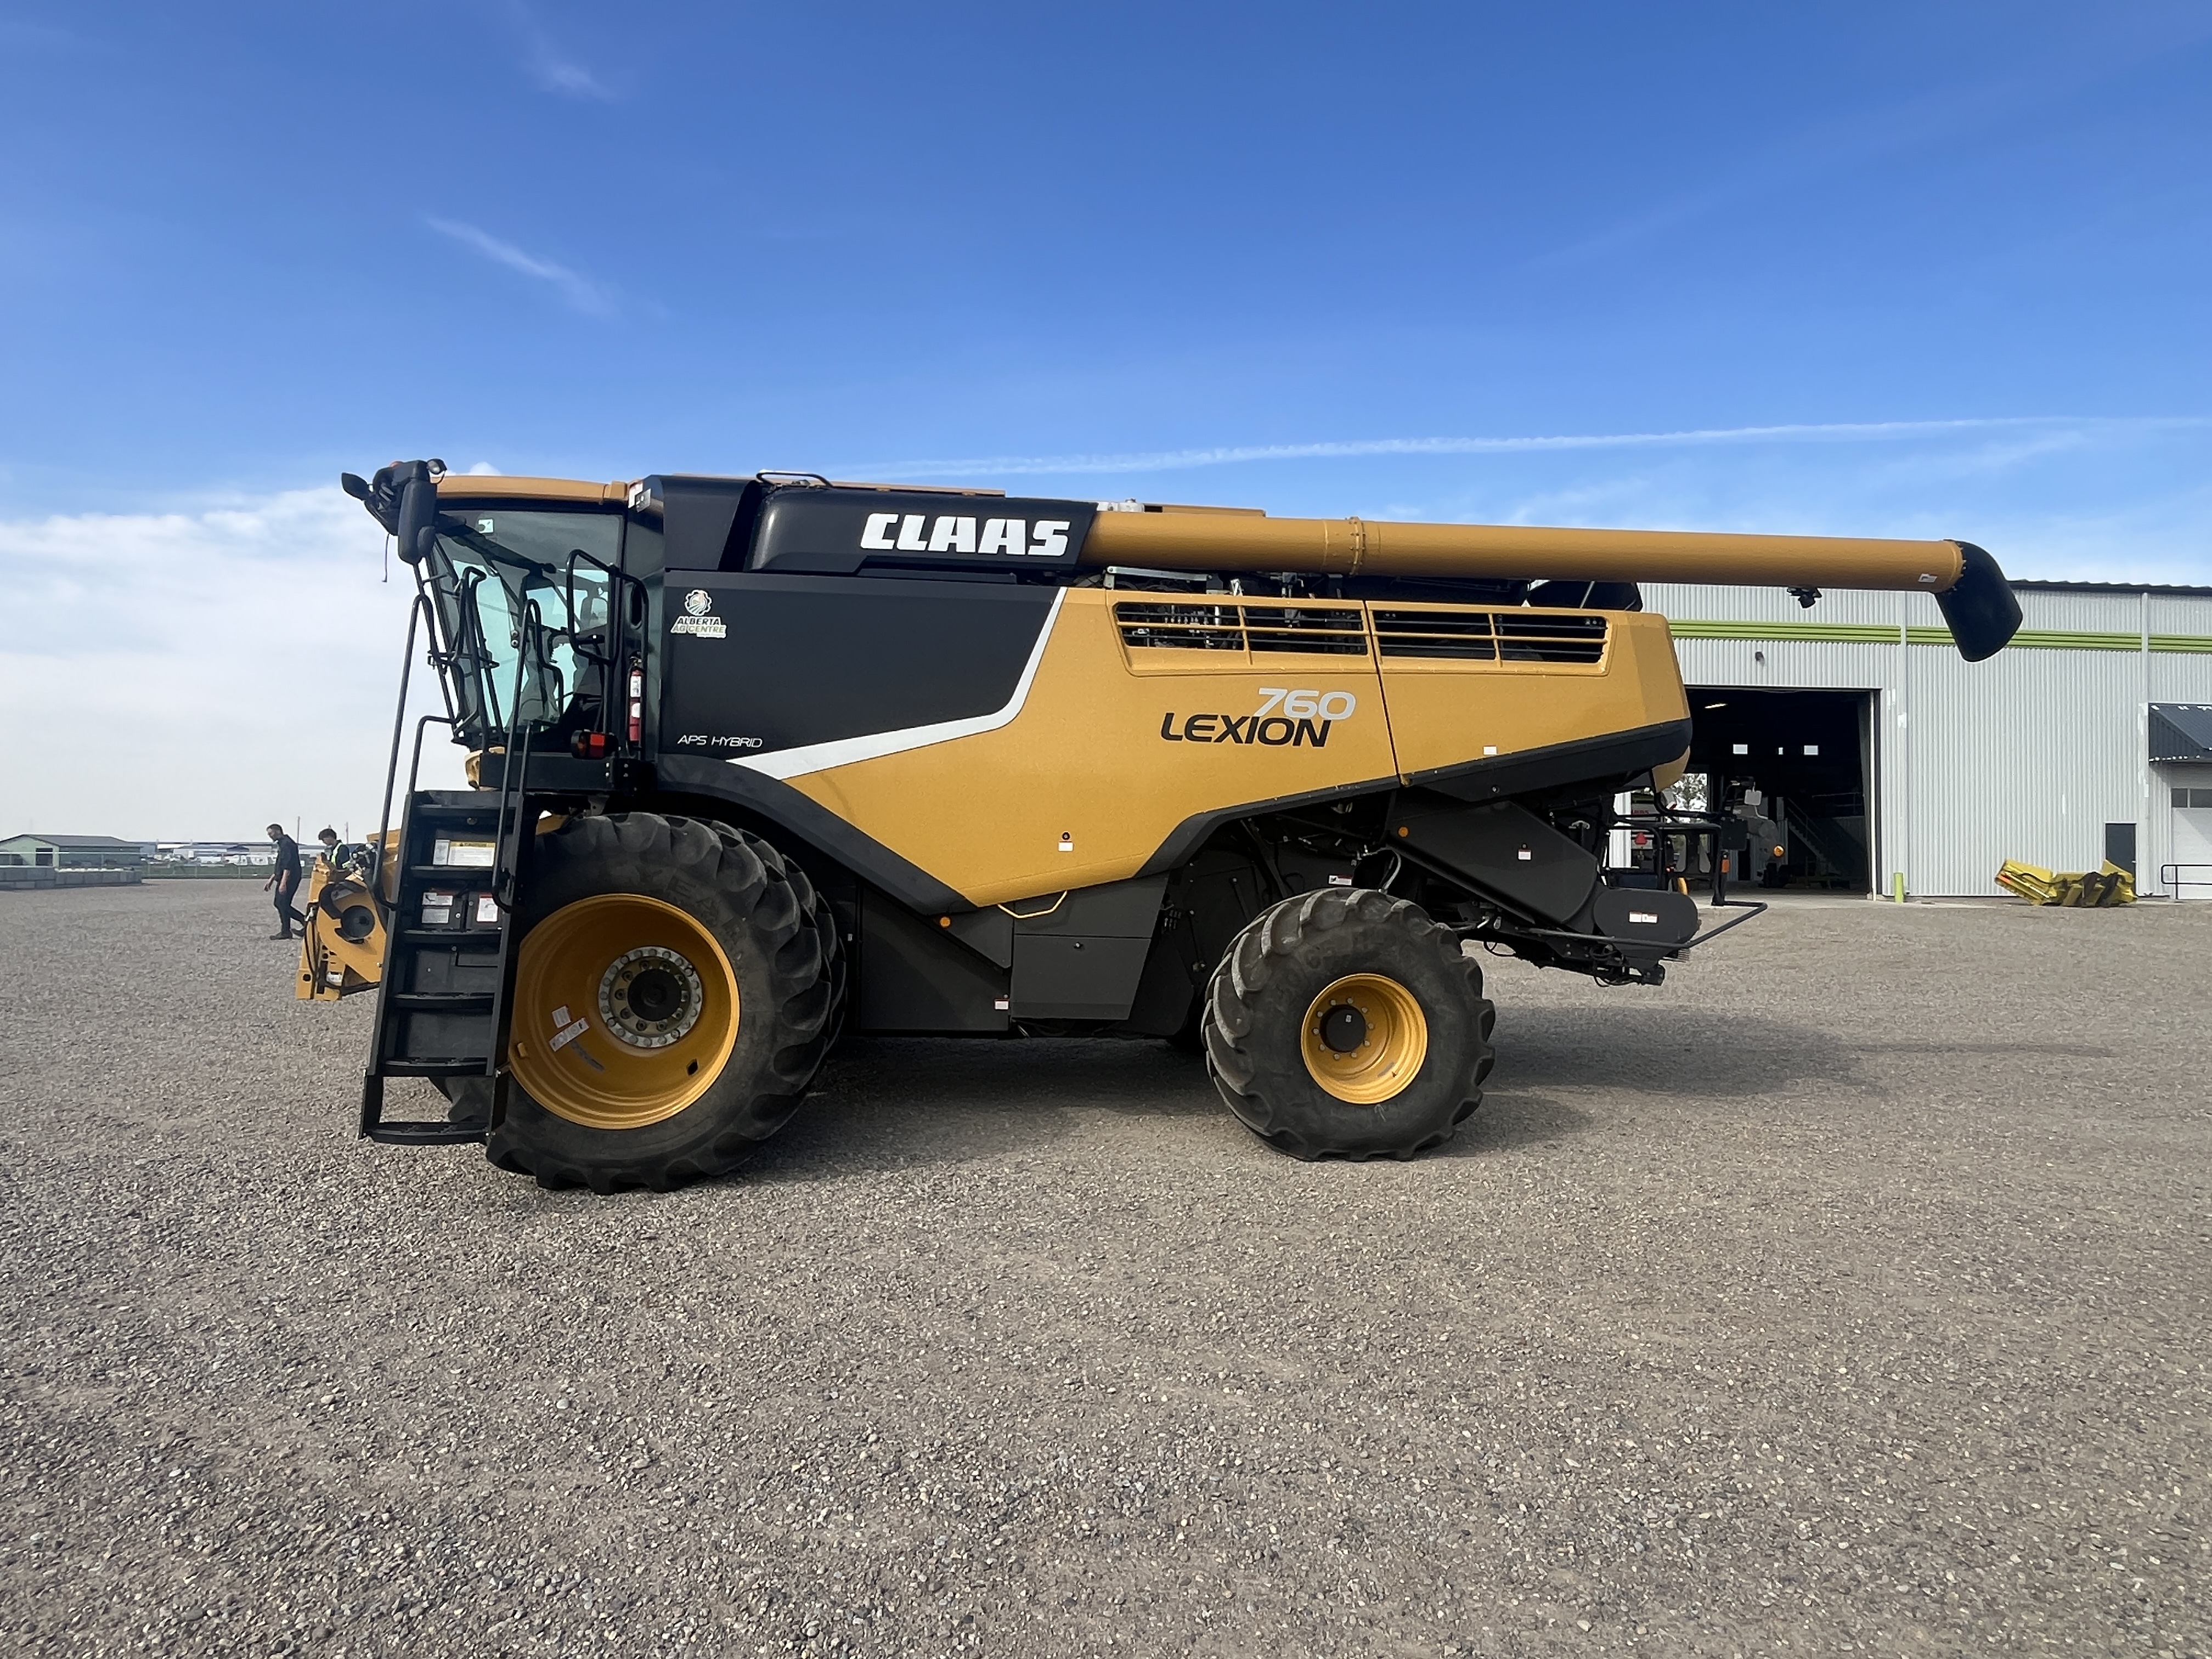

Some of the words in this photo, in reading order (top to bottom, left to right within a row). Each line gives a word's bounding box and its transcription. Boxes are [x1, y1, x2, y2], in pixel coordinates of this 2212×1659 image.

[860, 512, 1071, 556] CLAAS
[1254, 687, 1356, 720] 760
[677, 735, 708, 745] APS
[711, 736, 763, 748] HYBRID
[1160, 712, 1332, 747] LEXION
